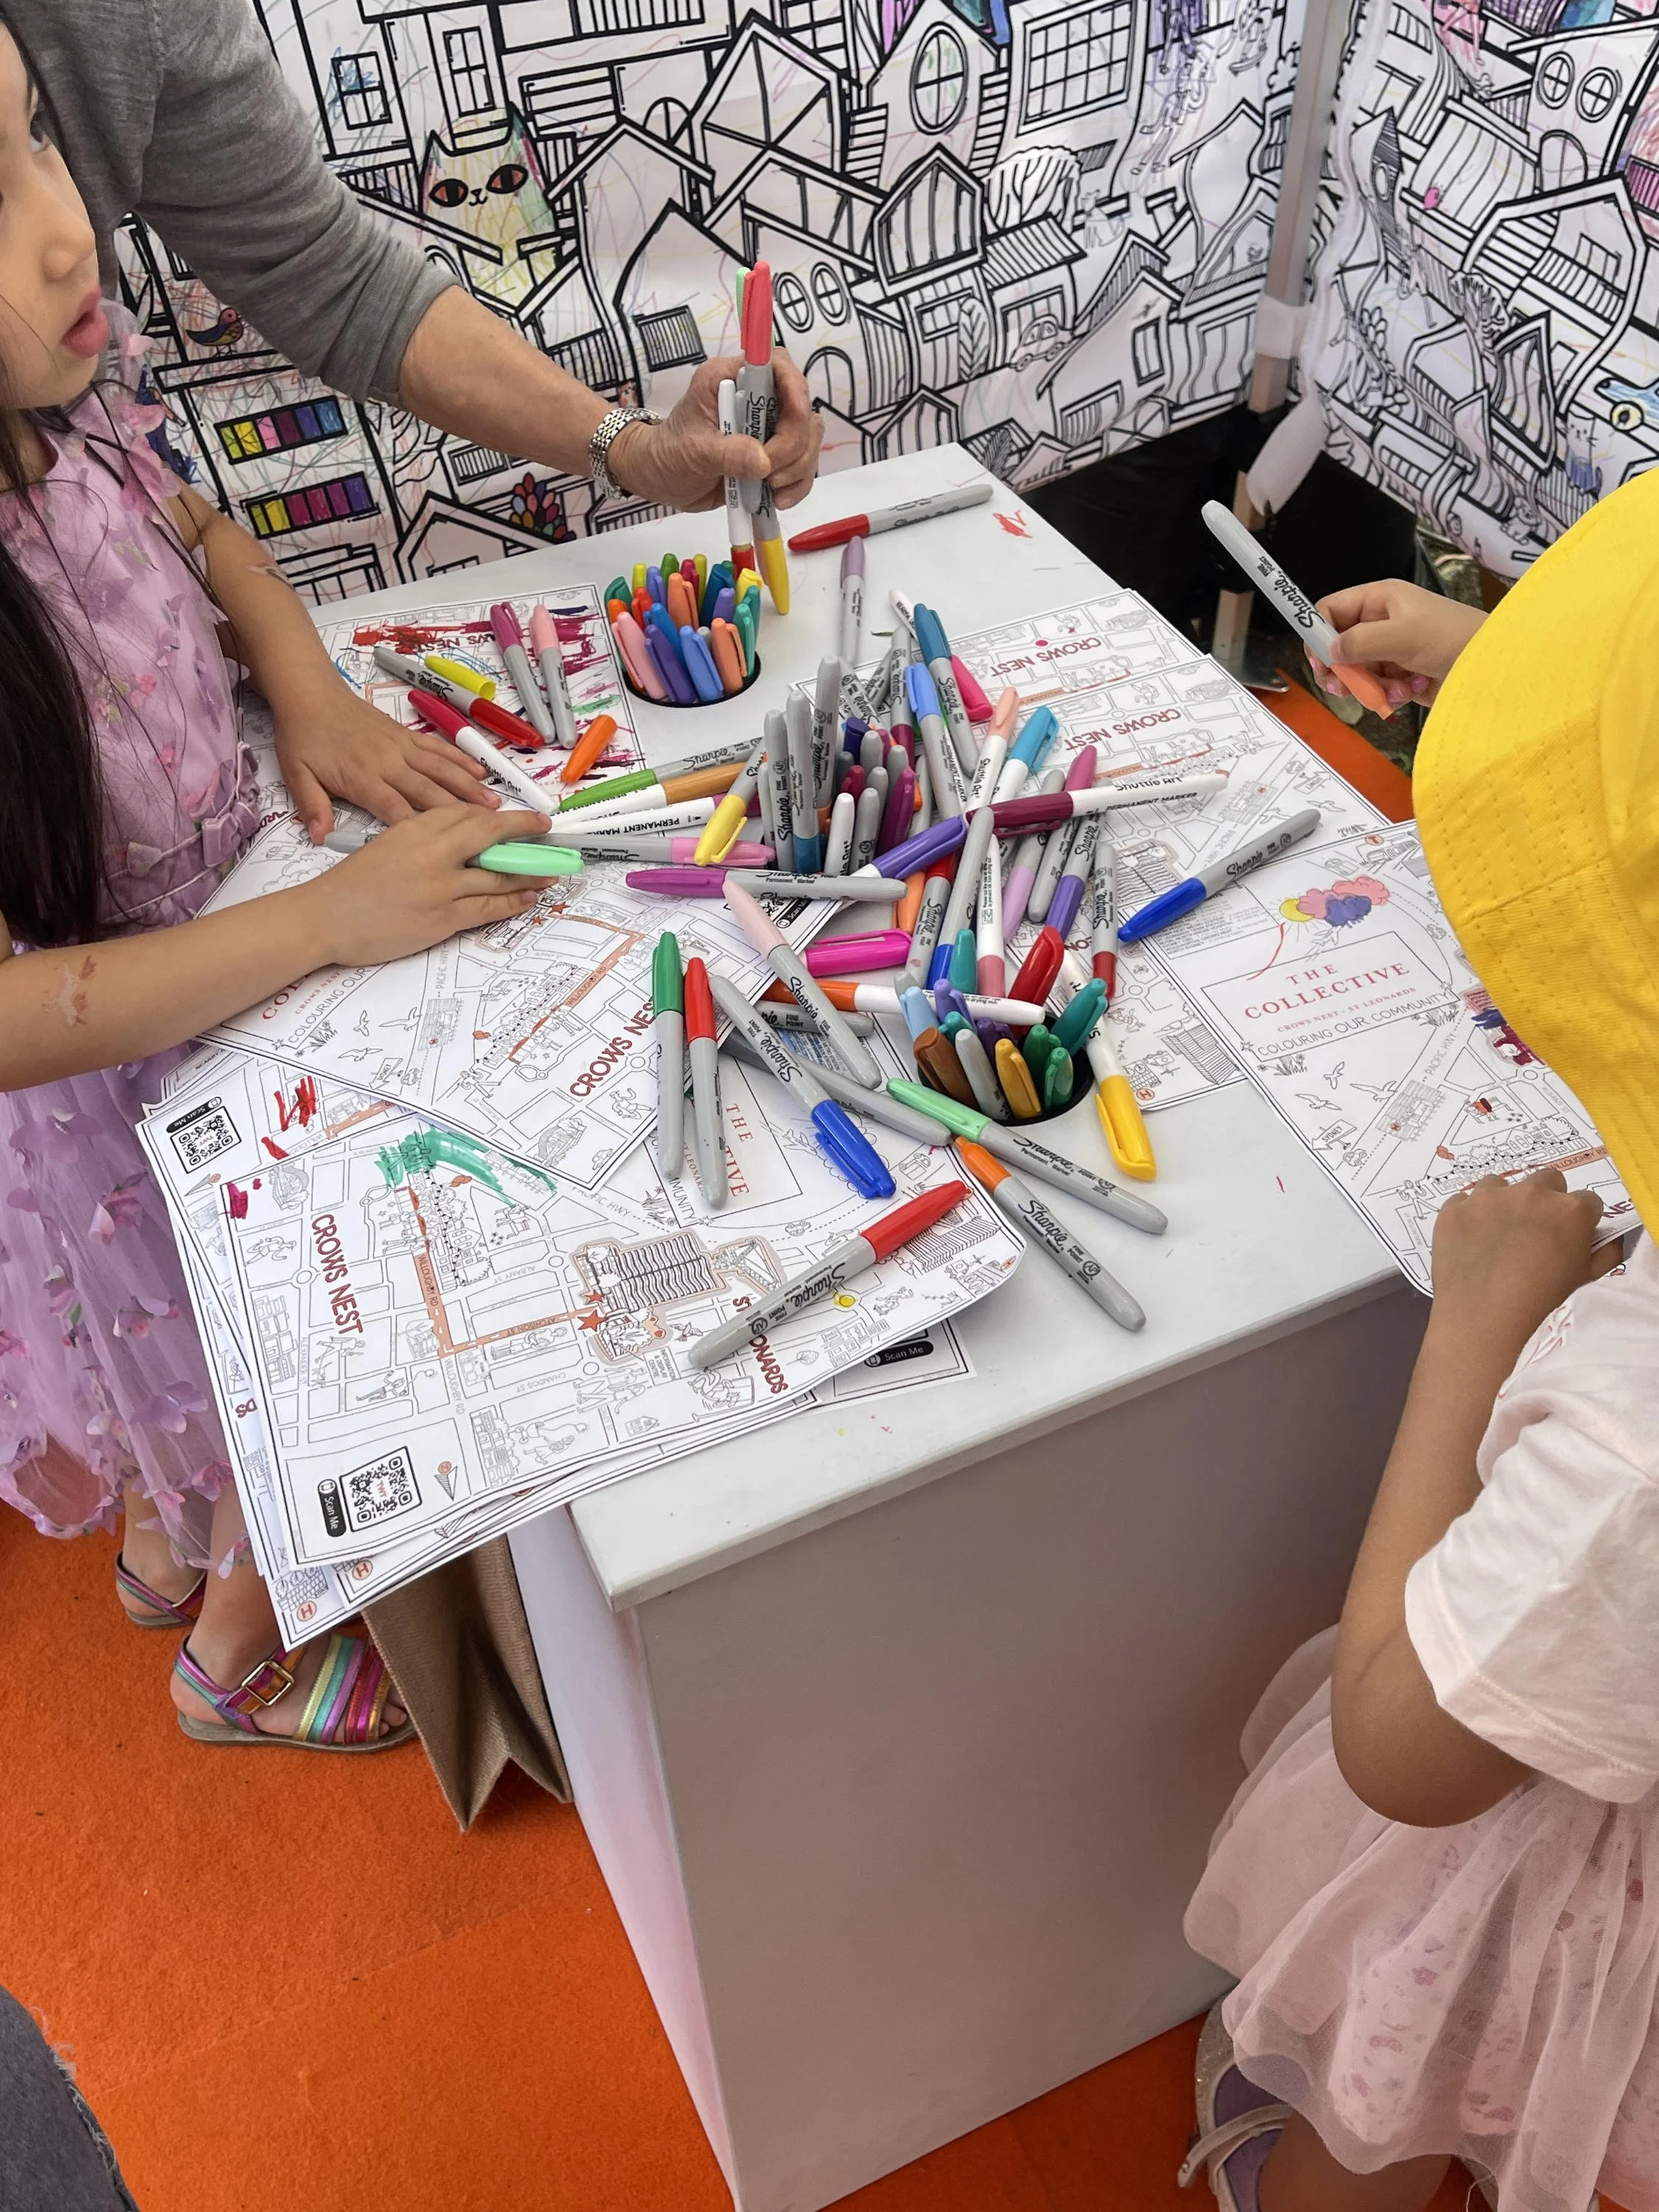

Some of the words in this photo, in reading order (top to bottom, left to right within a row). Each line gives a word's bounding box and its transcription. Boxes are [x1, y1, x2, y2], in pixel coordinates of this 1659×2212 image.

[1274, 574, 1325, 627] Sharpie
[1037, 637, 1102, 663] CROWS
[990, 656, 1034, 677] NEST
[418, 674, 453, 700] Sharpie
[854, 691, 880, 723] Sharpie
[1113, 709, 1180, 736] CROWS
[1065, 728, 1111, 751] NEST
[684, 747, 730, 770] Sharpie
[973, 758, 990, 786] Shuttle
[1116, 779, 1161, 792] Shuttle
[1164, 775, 1182, 785] Art
[956, 778, 967, 803] MARKER
[1106, 798, 1159, 810] PERMANENT
[1161, 791, 1197, 802] MARKER
[623, 818, 680, 833] PERMANENT
[776, 791, 793, 841] Sharpie
[1075, 824, 1099, 861] Sharpie
[1226, 850, 1263, 877] Sharpie
[786, 906, 799, 921] Scan
[922, 897, 942, 935] Sharpie
[1093, 891, 1107, 930] Sharpie
[437, 963, 447, 989] PACIFIC
[567, 972, 599, 1006] WILLOUGHBY
[597, 965, 607, 975] RD
[1286, 964, 1338, 986] THE
[296, 987, 321, 1015] CROWS
[790, 976, 818, 1020] Sharpie
[1245, 962, 1410, 1020] COLLECTIVE
[288, 989, 344, 1043] COLOURING
[341, 967, 372, 988] OUR
[1278, 1016, 1312, 1033] CROWS
[1315, 1010, 1340, 1023] NEST
[1347, 1002, 1360, 1011] ST
[1362, 987, 1416, 1008] LEONARDS
[1257, 1029, 1333, 1057] COLOURING
[1334, 1016, 1371, 1033] OUR
[1371, 992, 1448, 1022] COMMUNITY
[570, 1037, 632, 1097] CROWS
[624, 997, 656, 1036] NES
[760, 1032, 803, 1082] Sharpie
[1425, 1048, 1444, 1077] PACIFIC
[1441, 1032, 1458, 1051] HWY
[1542, 1086, 1562, 1107] ALBANY
[173, 1119, 187, 1128] Me
[187, 1107, 206, 1121] Scan
[726, 1103, 754, 1142] THE
[1321, 1124, 1344, 1143] SYDNEY
[1013, 1138, 1074, 1171] Sharpie
[1021, 1148, 1048, 1166] Permanent
[1052, 1164, 1071, 1176] Marker
[609, 1201, 631, 1217] HWY
[667, 1178, 696, 1221] MUNITY
[1602, 1199, 1635, 1219] NE
[1018, 1200, 1068, 1247] Sharpie
[1023, 1215, 1044, 1238] Permanent
[312, 1214, 348, 1283] CROWS
[1067, 1248, 1083, 1264] POINT
[418, 1255, 437, 1294] WILLOUGHBY
[431, 1295, 439, 1307] RD
[505, 1265, 535, 1281] ALBANY
[793, 1262, 846, 1308] Sharpie
[328, 1283, 364, 1334] NEST
[768, 1304, 785, 1318] POINT
[507, 1328, 516, 1336] ST
[517, 1317, 556, 1332] ATCHISON
[732, 1295, 752, 1312] ST
[750, 1333, 788, 1394] ONARDS
[885, 1349, 906, 1361] Scan
[910, 1344, 925, 1357] Me
[648, 1359, 659, 1379] CENTRE
[656, 1360, 668, 1379] DISPLAY
[661, 1347, 678, 1382] INFORMATION
[445, 1358, 463, 1404] WILLOUGHBY
[456, 1402, 466, 1416] RD
[516, 1385, 526, 1394] ST
[526, 1372, 567, 1390] CHANDOS
[377, 1481, 387, 1498] TWT
[324, 1496, 335, 1514] Scan
[329, 1516, 339, 1530] Me
